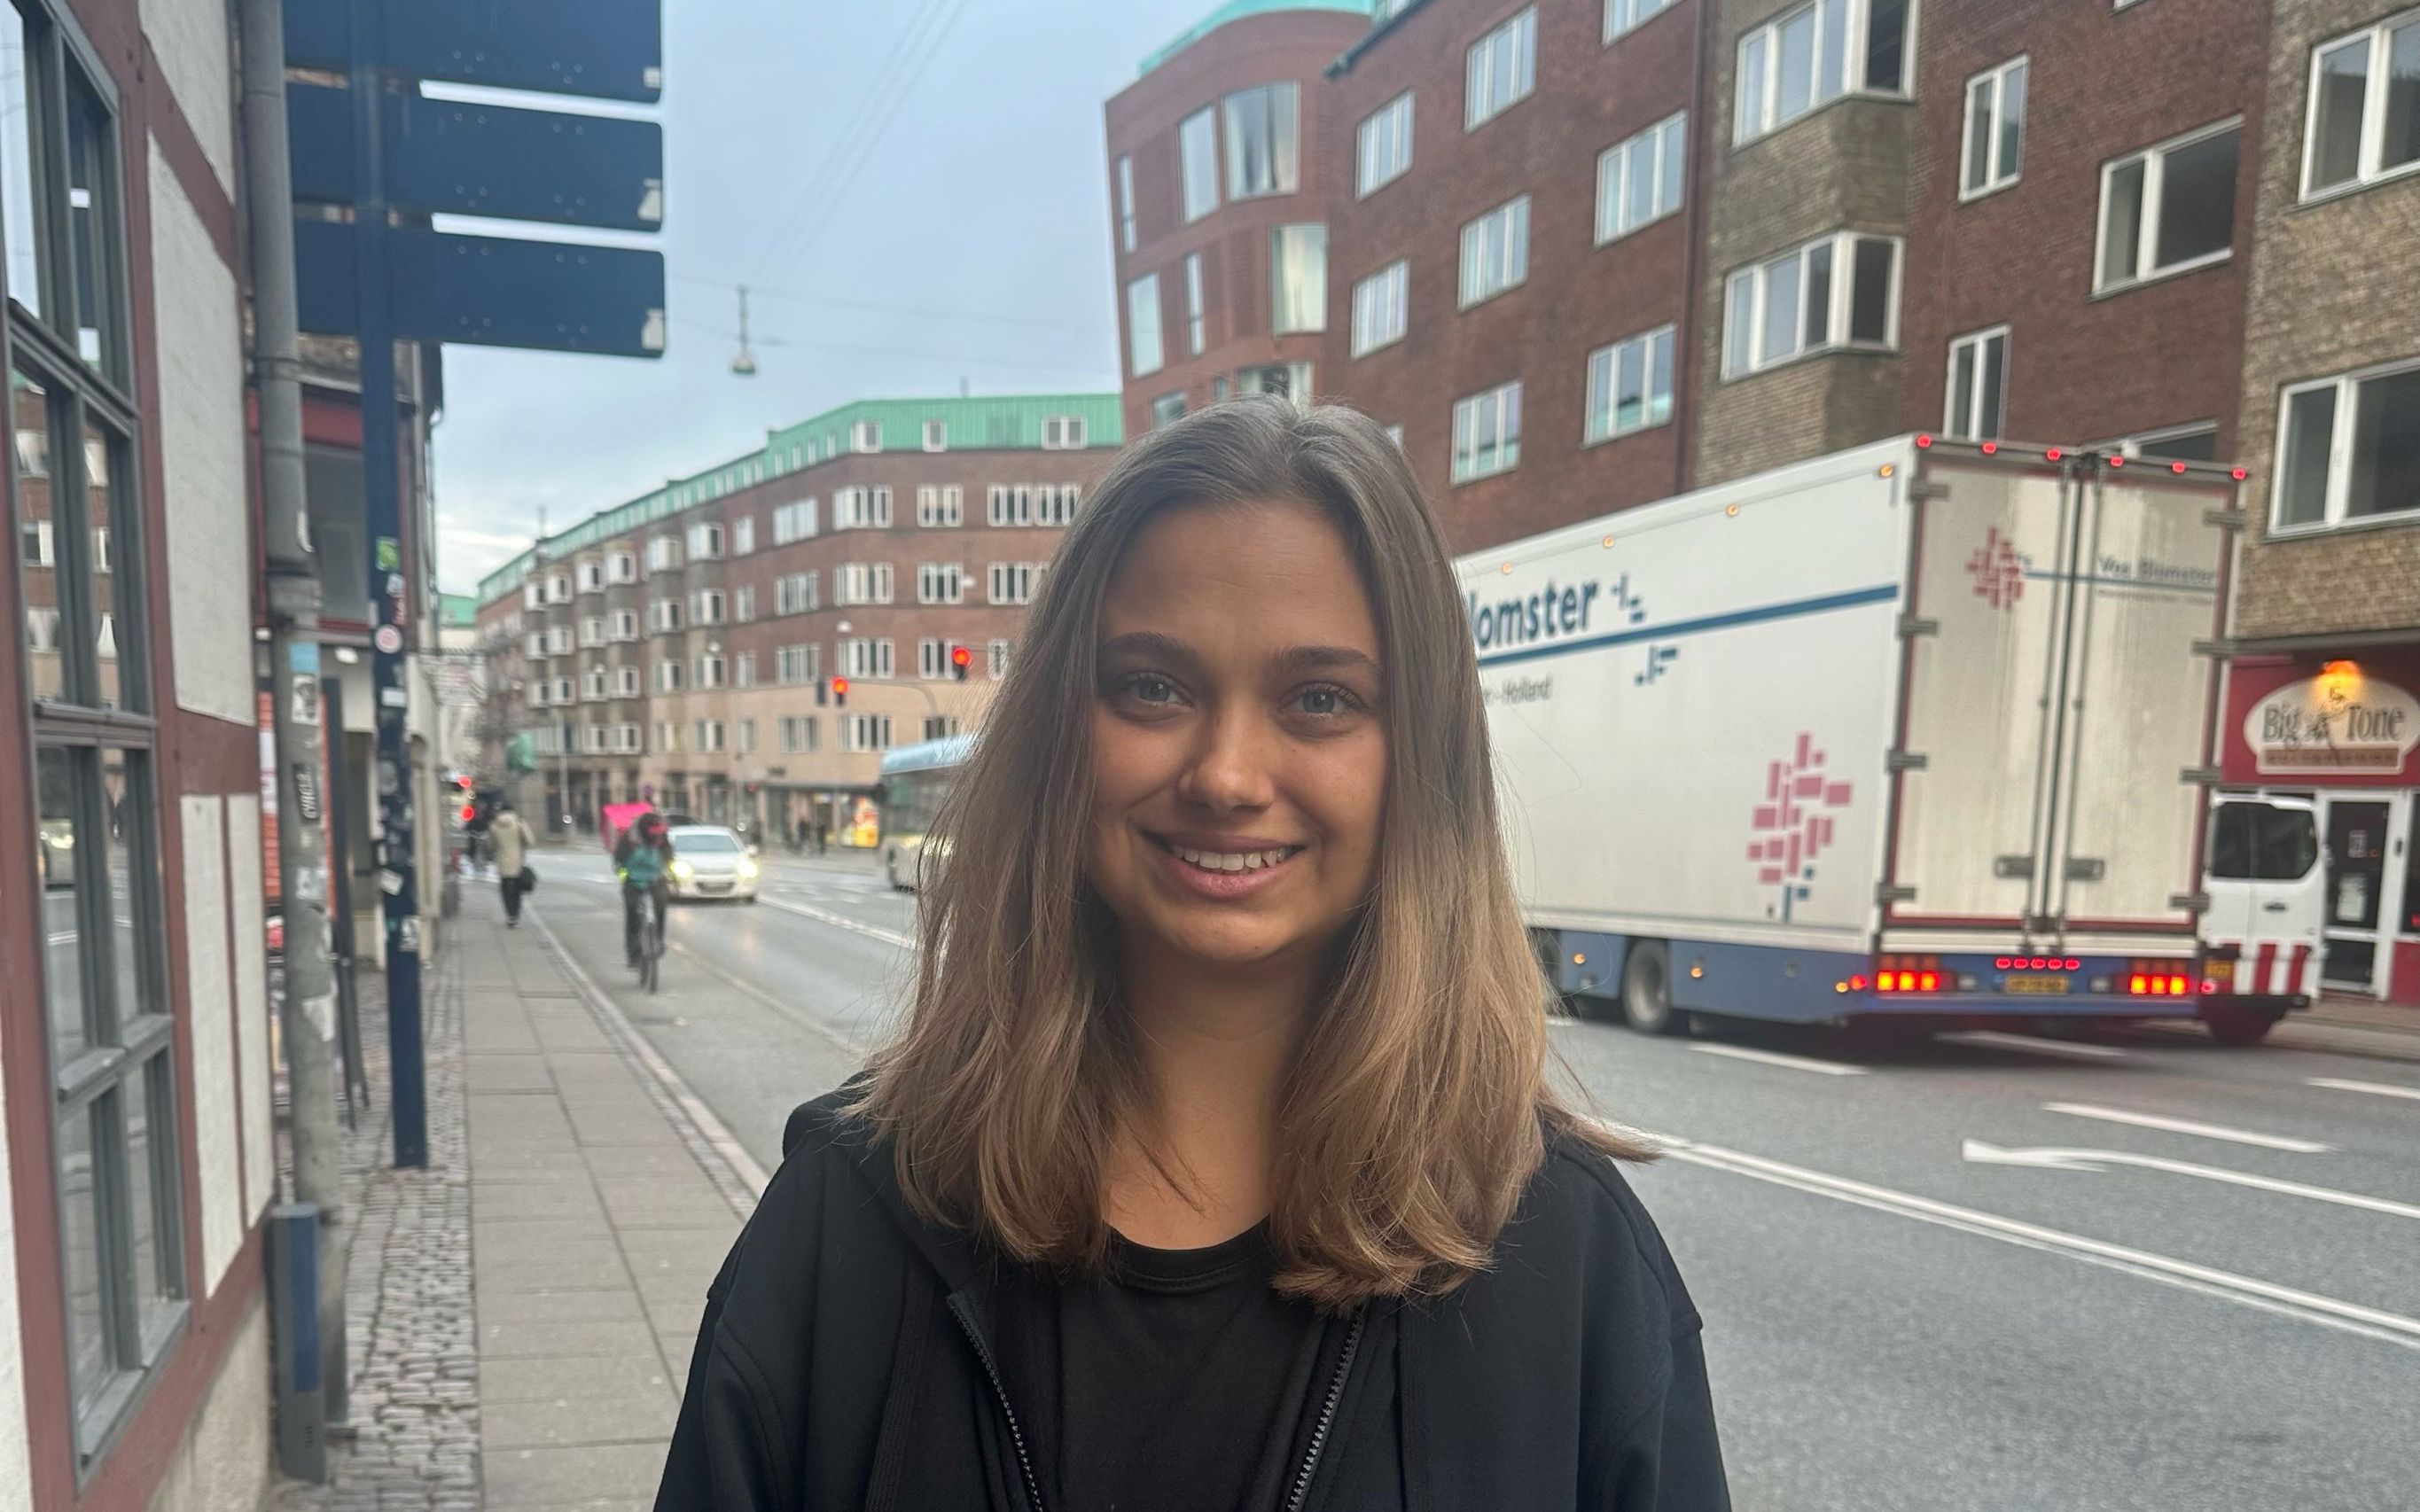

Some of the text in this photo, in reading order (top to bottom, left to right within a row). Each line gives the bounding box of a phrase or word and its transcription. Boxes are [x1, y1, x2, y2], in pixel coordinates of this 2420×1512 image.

[1502, 674, 1552, 705] Holland
[2262, 702, 2405, 752] Big Tone
